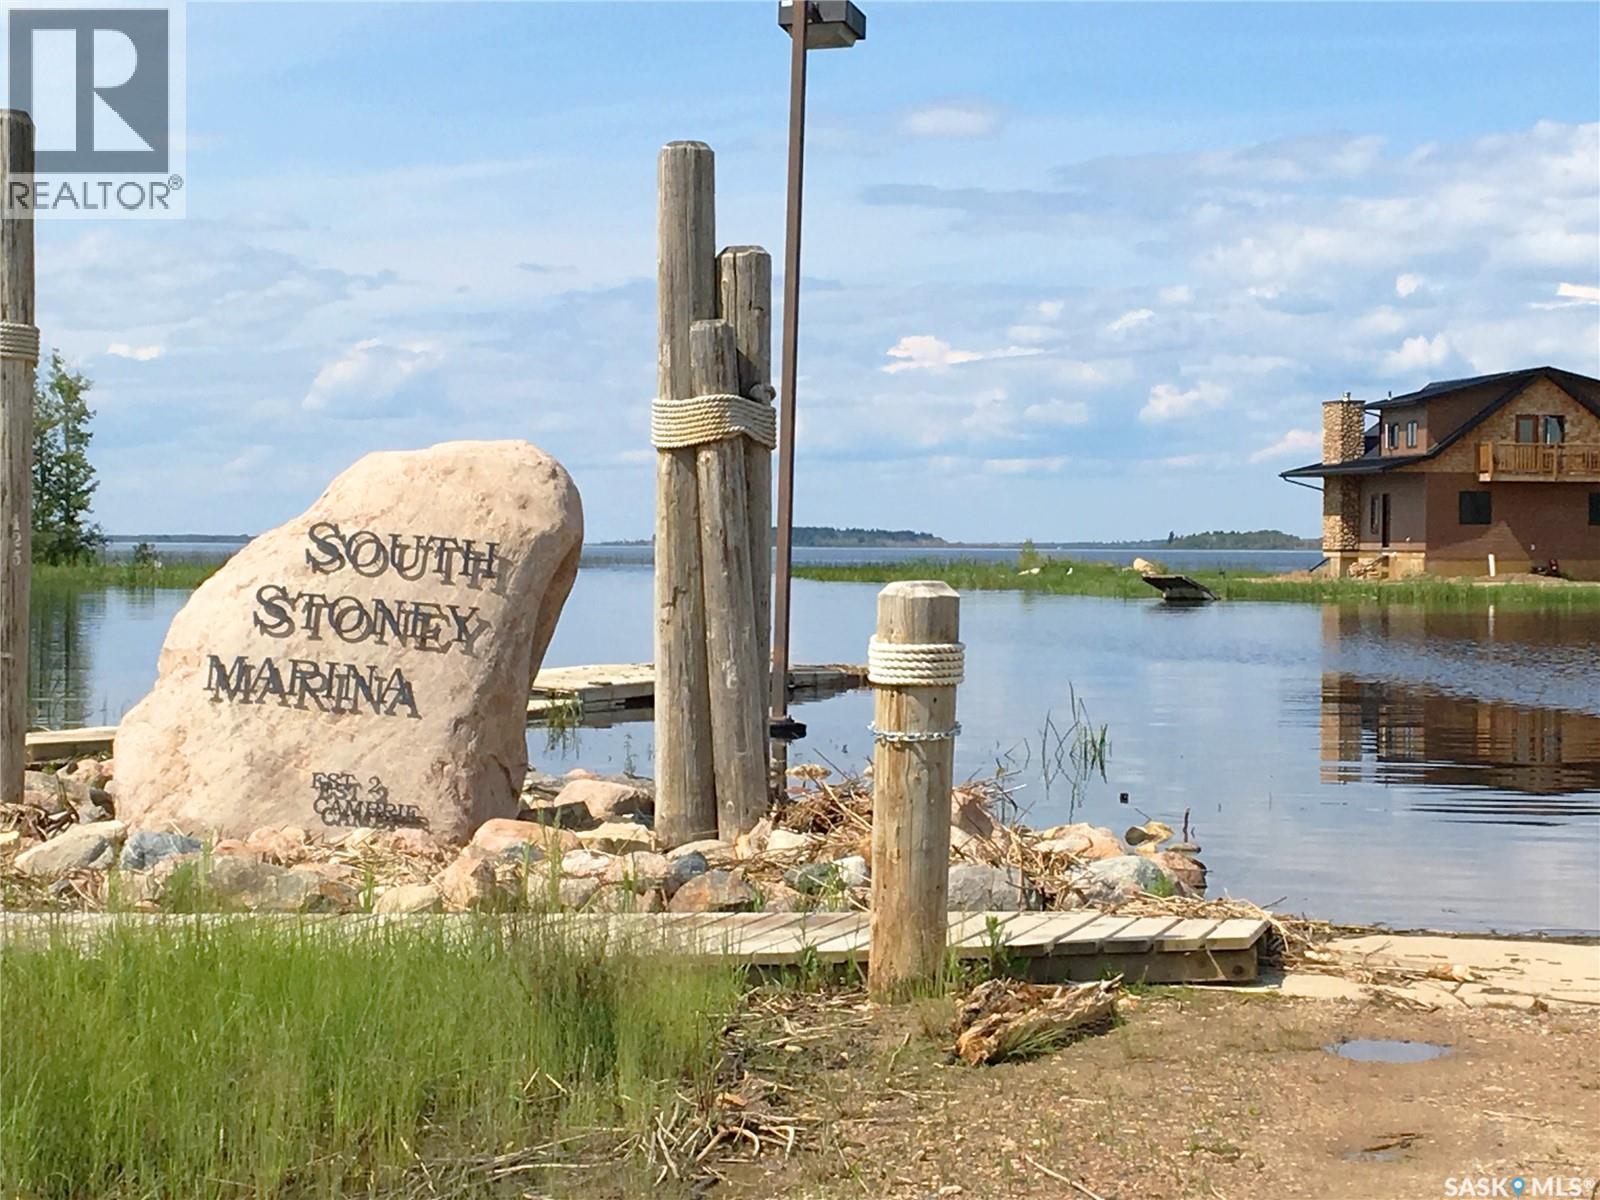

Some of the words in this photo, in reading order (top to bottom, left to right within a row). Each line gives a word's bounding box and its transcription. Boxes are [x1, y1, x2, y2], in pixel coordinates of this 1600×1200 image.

[306, 521, 503, 584] SOUTH
[253, 584, 483, 648] STONEY
[203, 654, 414, 709] MARINA
